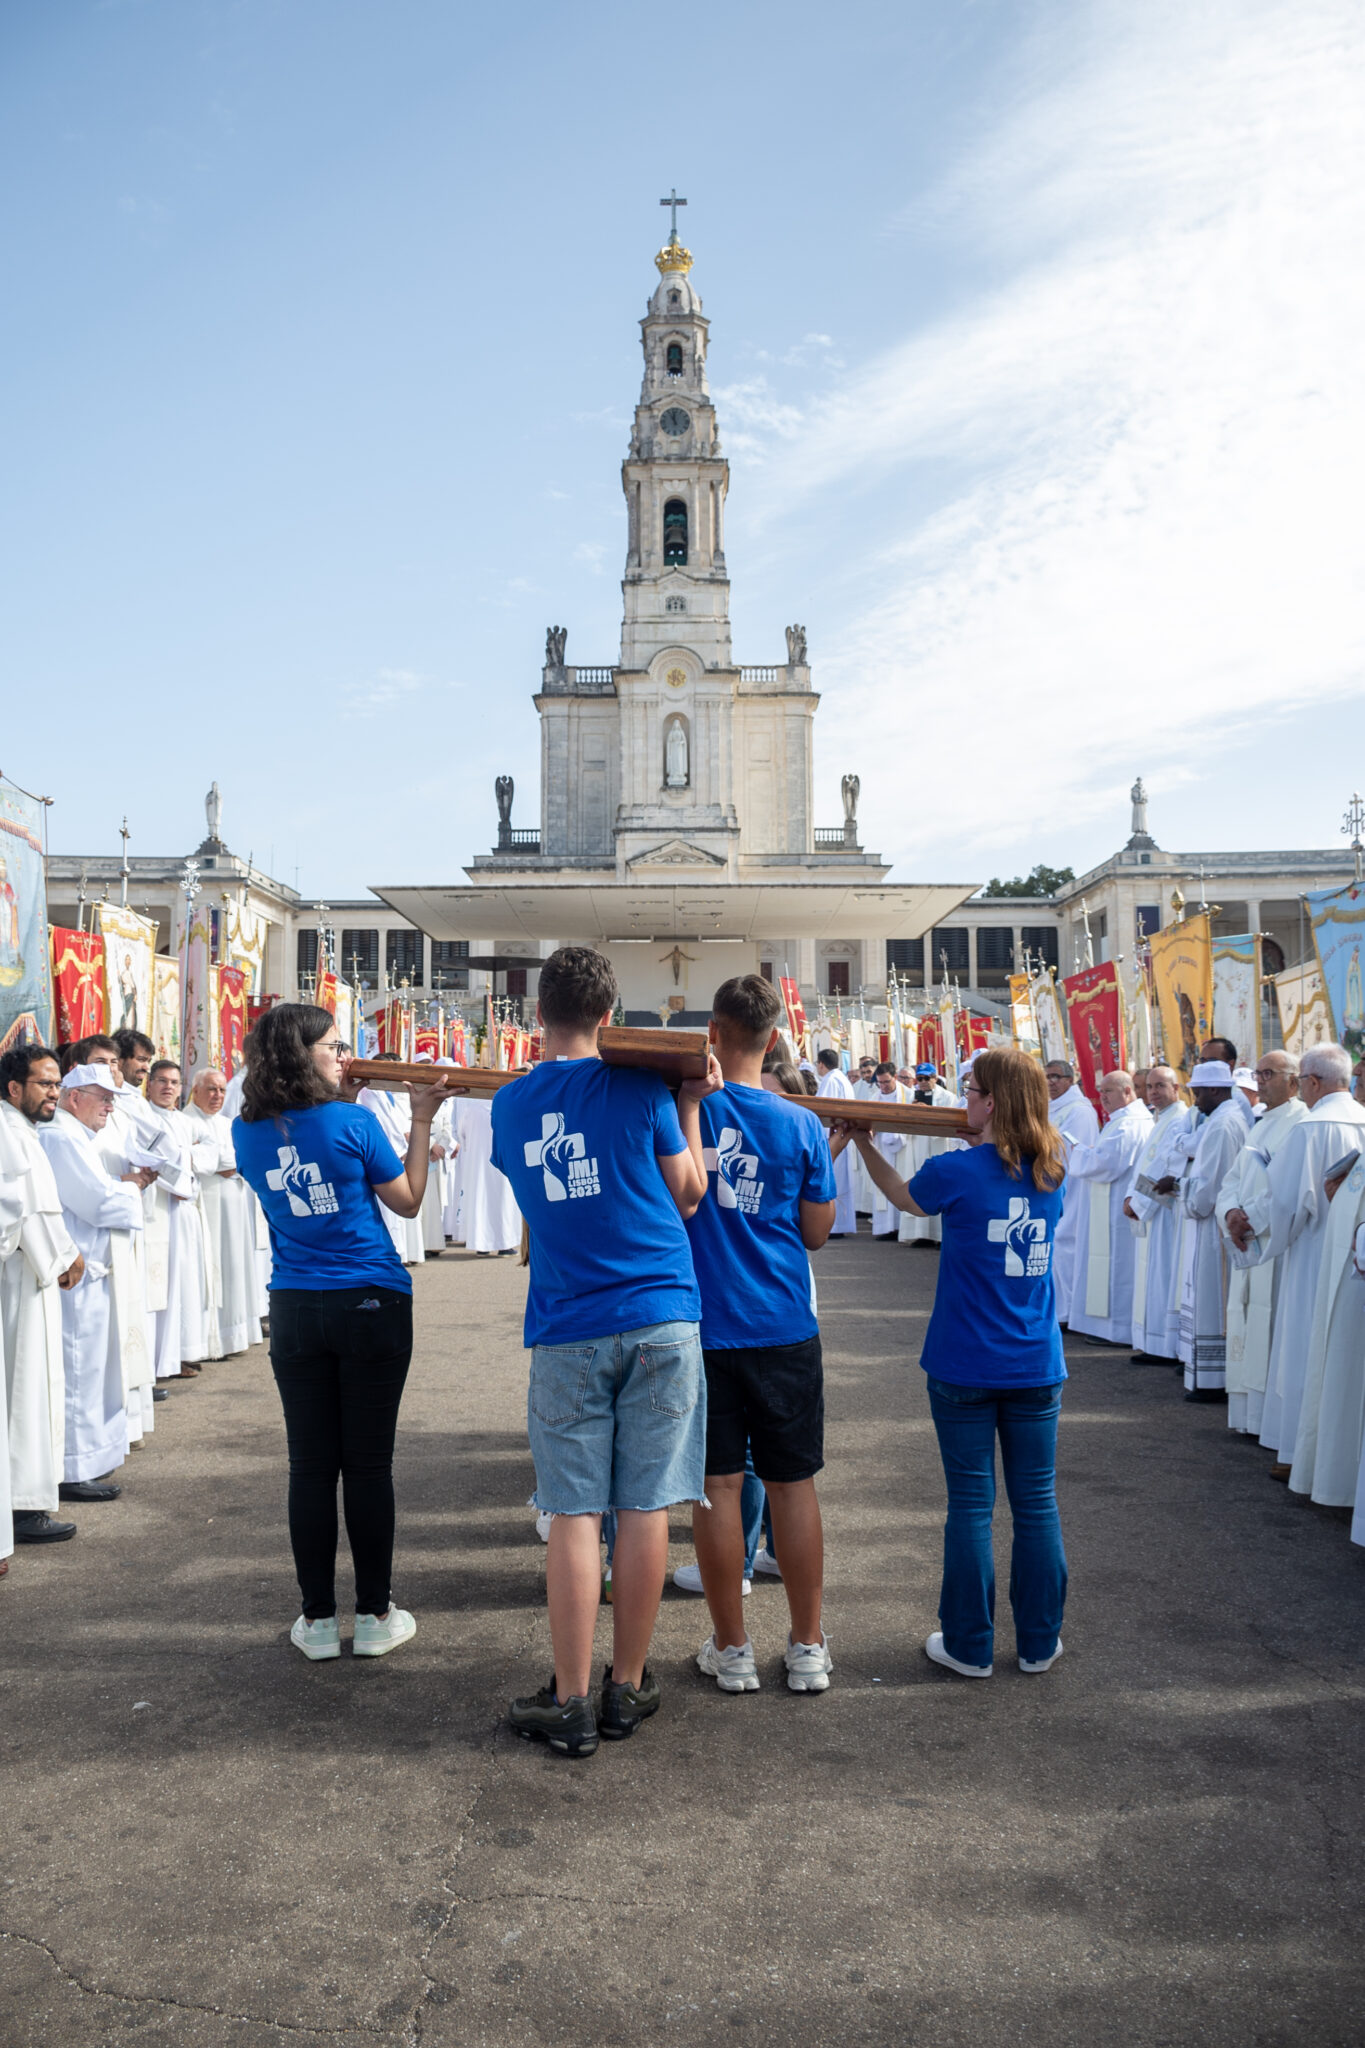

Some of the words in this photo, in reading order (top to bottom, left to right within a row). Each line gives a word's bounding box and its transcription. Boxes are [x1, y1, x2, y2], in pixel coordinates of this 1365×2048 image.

[568, 1158, 598, 1180] JMJ
[568, 1176, 600, 1187] LISBOA
[735, 1178, 764, 1197] JMJ
[308, 1183, 335, 1200] JMJ
[569, 1183, 601, 1199] 2023
[310, 1197, 337, 1206] LISBOA
[313, 1203, 339, 1214] 2023
[1028, 1242, 1050, 1259] JMJ
